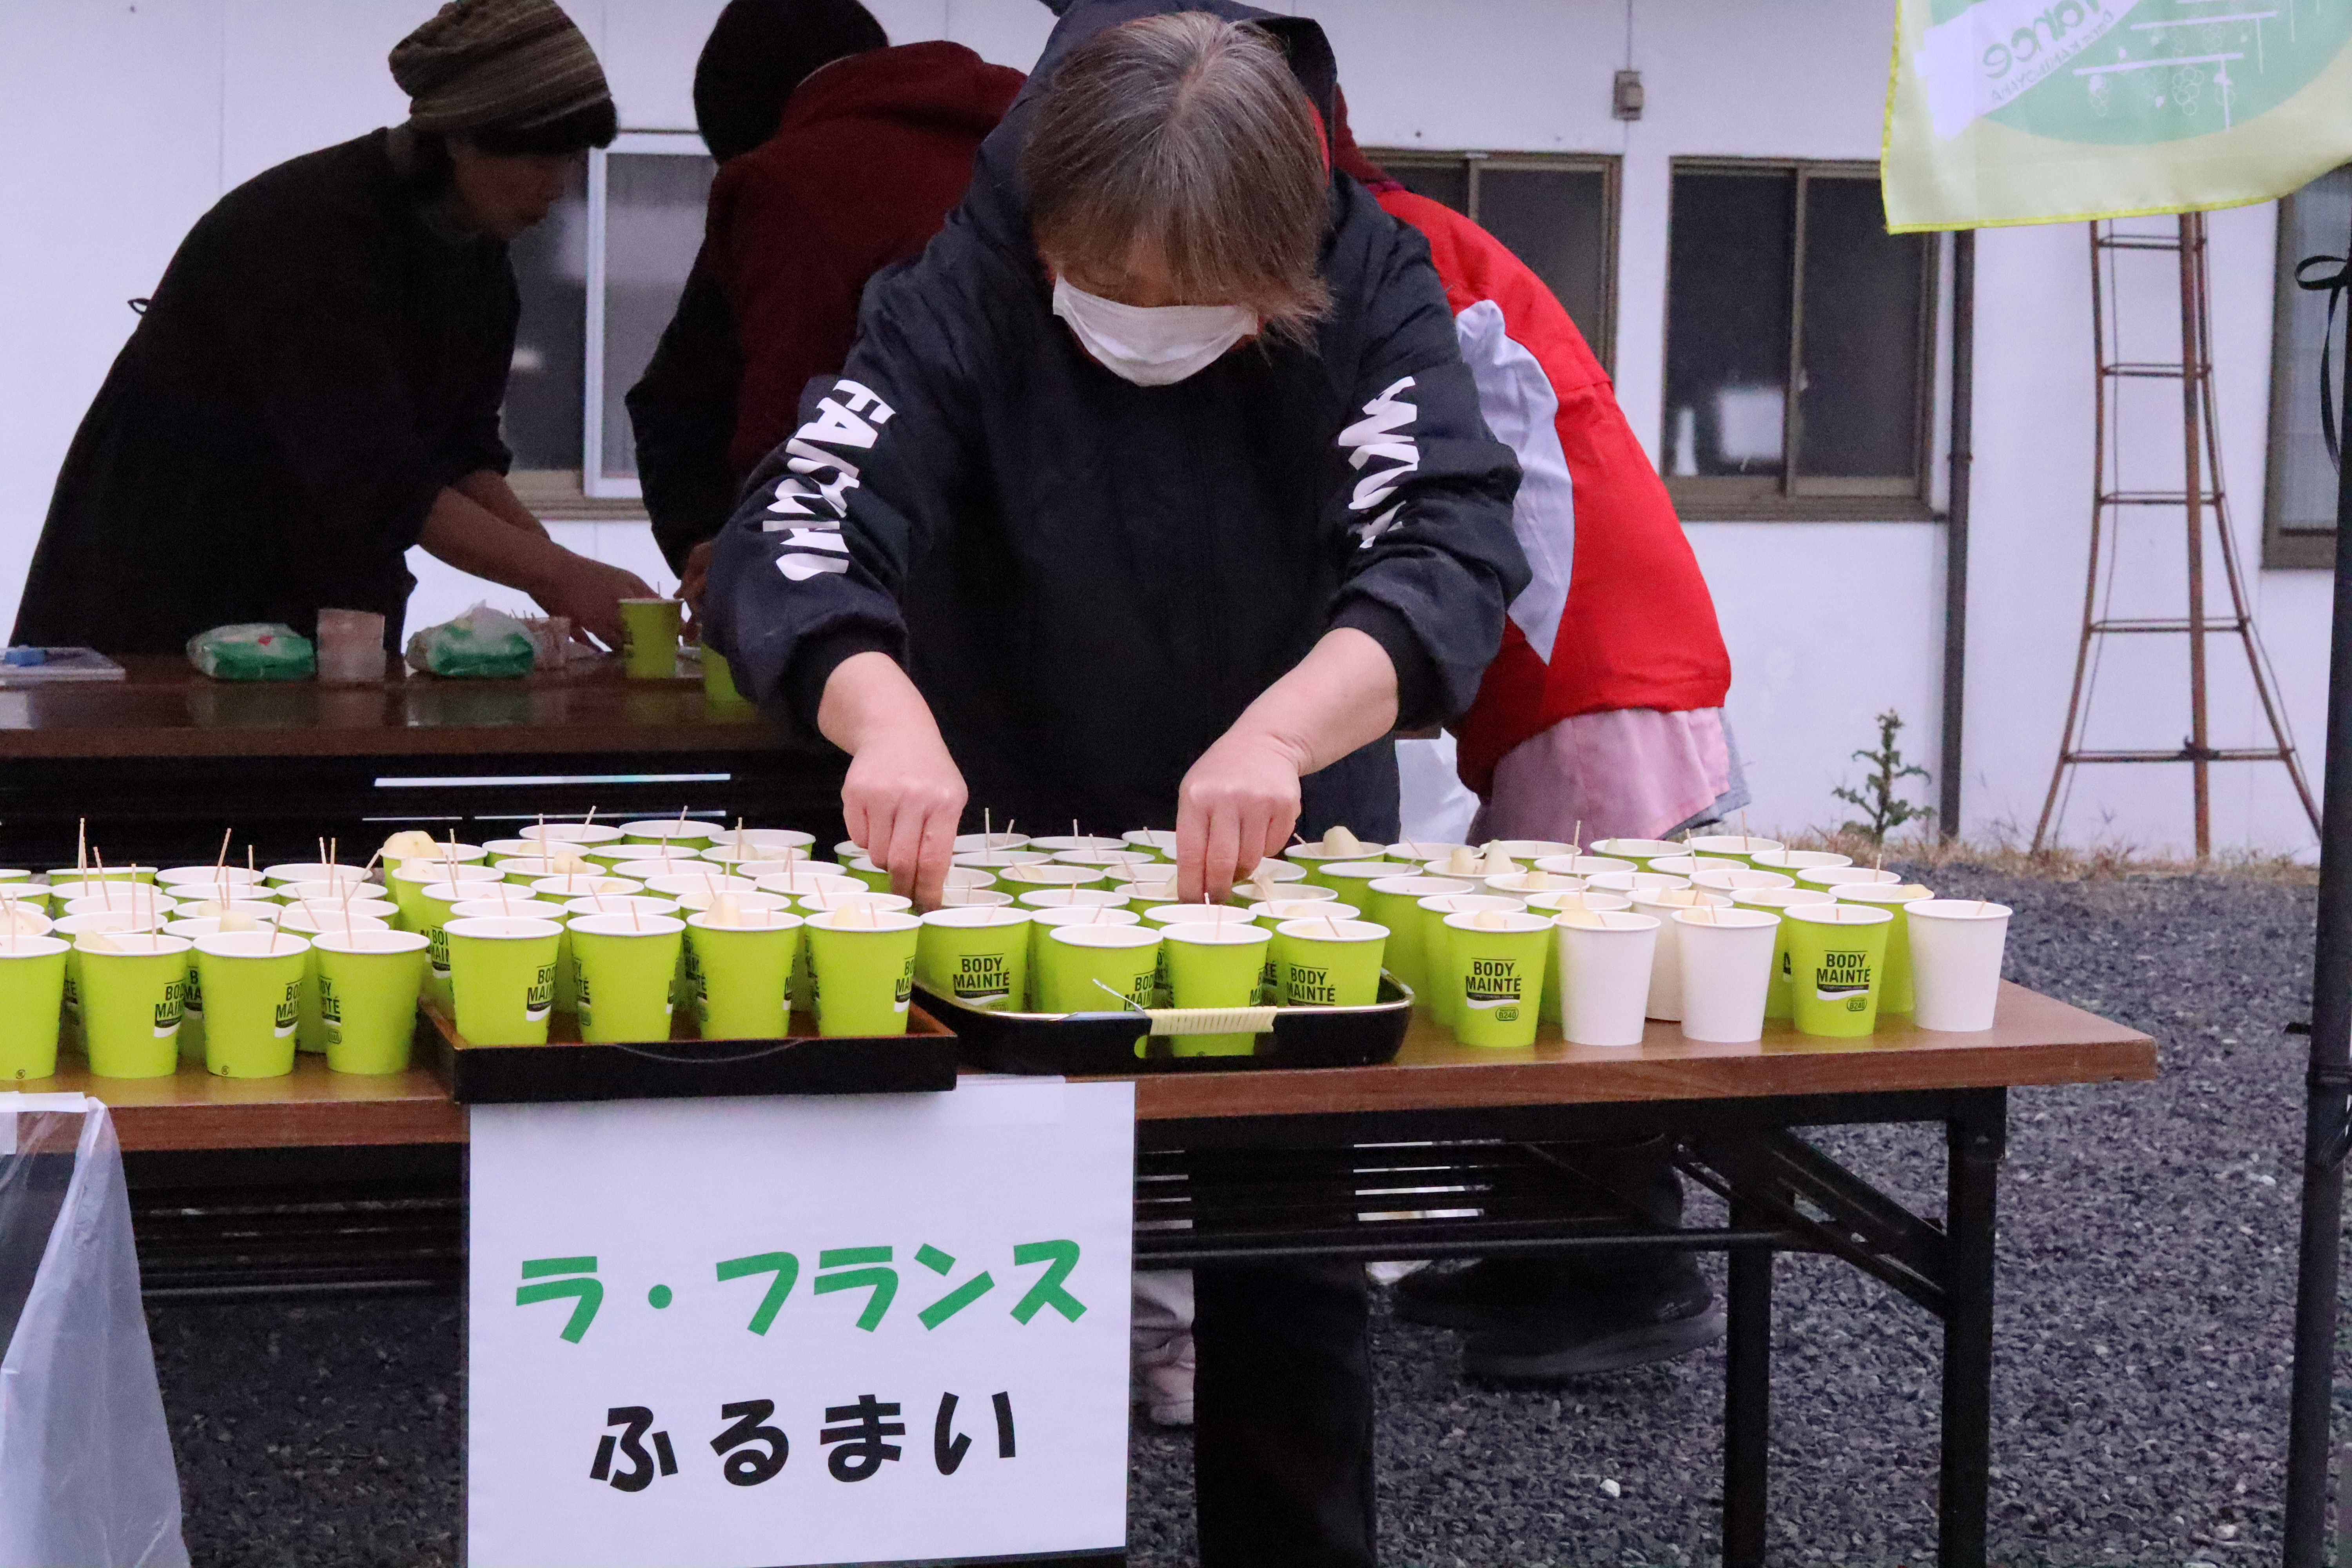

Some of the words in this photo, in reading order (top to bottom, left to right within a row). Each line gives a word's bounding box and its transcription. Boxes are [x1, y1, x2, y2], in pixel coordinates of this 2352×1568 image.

[962, 957, 1003, 973] BODY
[1474, 961, 1515, 976] BODY
[1826, 954, 1866, 968] BODY
[953, 968, 1010, 988] MAINTÉ
[1290, 967, 1327, 985] BODY
[1817, 965, 1871, 983] MAINTÉ
[1287, 981, 1336, 1002] MAINTÉ
[1465, 975, 1522, 993] MAINTÉ
[516, 1240, 1086, 1343] ラ・フランス
[590, 1392, 1015, 1492] ふるまい
